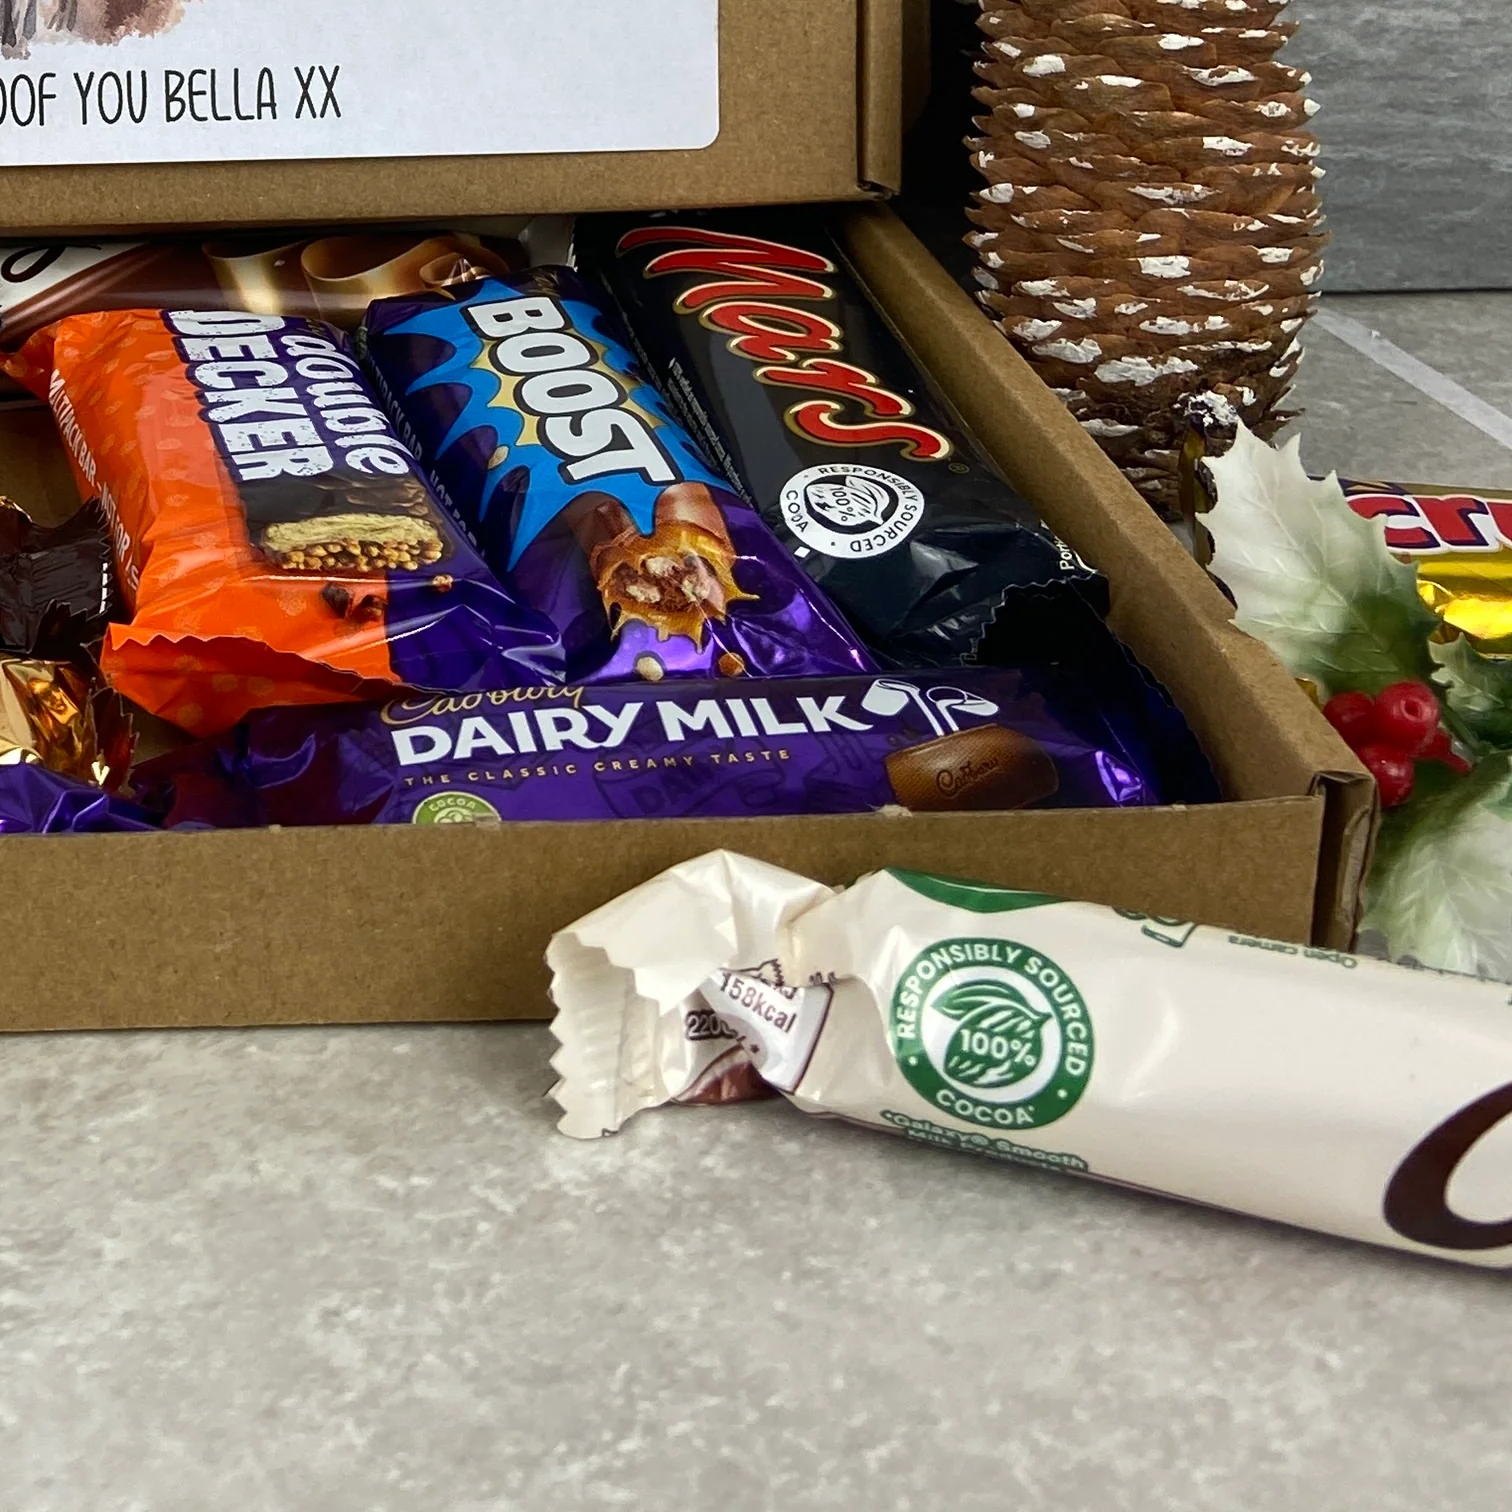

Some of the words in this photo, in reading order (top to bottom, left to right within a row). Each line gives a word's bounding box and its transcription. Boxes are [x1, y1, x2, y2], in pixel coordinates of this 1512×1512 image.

[74, 70, 147, 125] YOU
[165, 68, 276, 122] BELLA
[294, 66, 341, 118] XX
[615, 226, 955, 462] Mars
[169, 310, 334, 482] DECKER
[464, 296, 678, 483] BOOST
[818, 466, 919, 502] RESPONSIBLY
[829, 486, 857, 522] 100%
[849, 504, 918, 553] SOURCED
[391, 701, 643, 766] DAIRY
[658, 693, 874, 743] MILK
[404, 774, 452, 787] THE
[468, 763, 577, 781] CLASSIC
[593, 756, 694, 772] CREAMY
[710, 748, 791, 764] TASTE
[935, 758, 1001, 796] Cadbury
[896, 943, 1022, 1040] RESPONSIBLY
[1024, 955, 1089, 1077] SOURCED
[959, 1028, 1036, 1067] 100%
